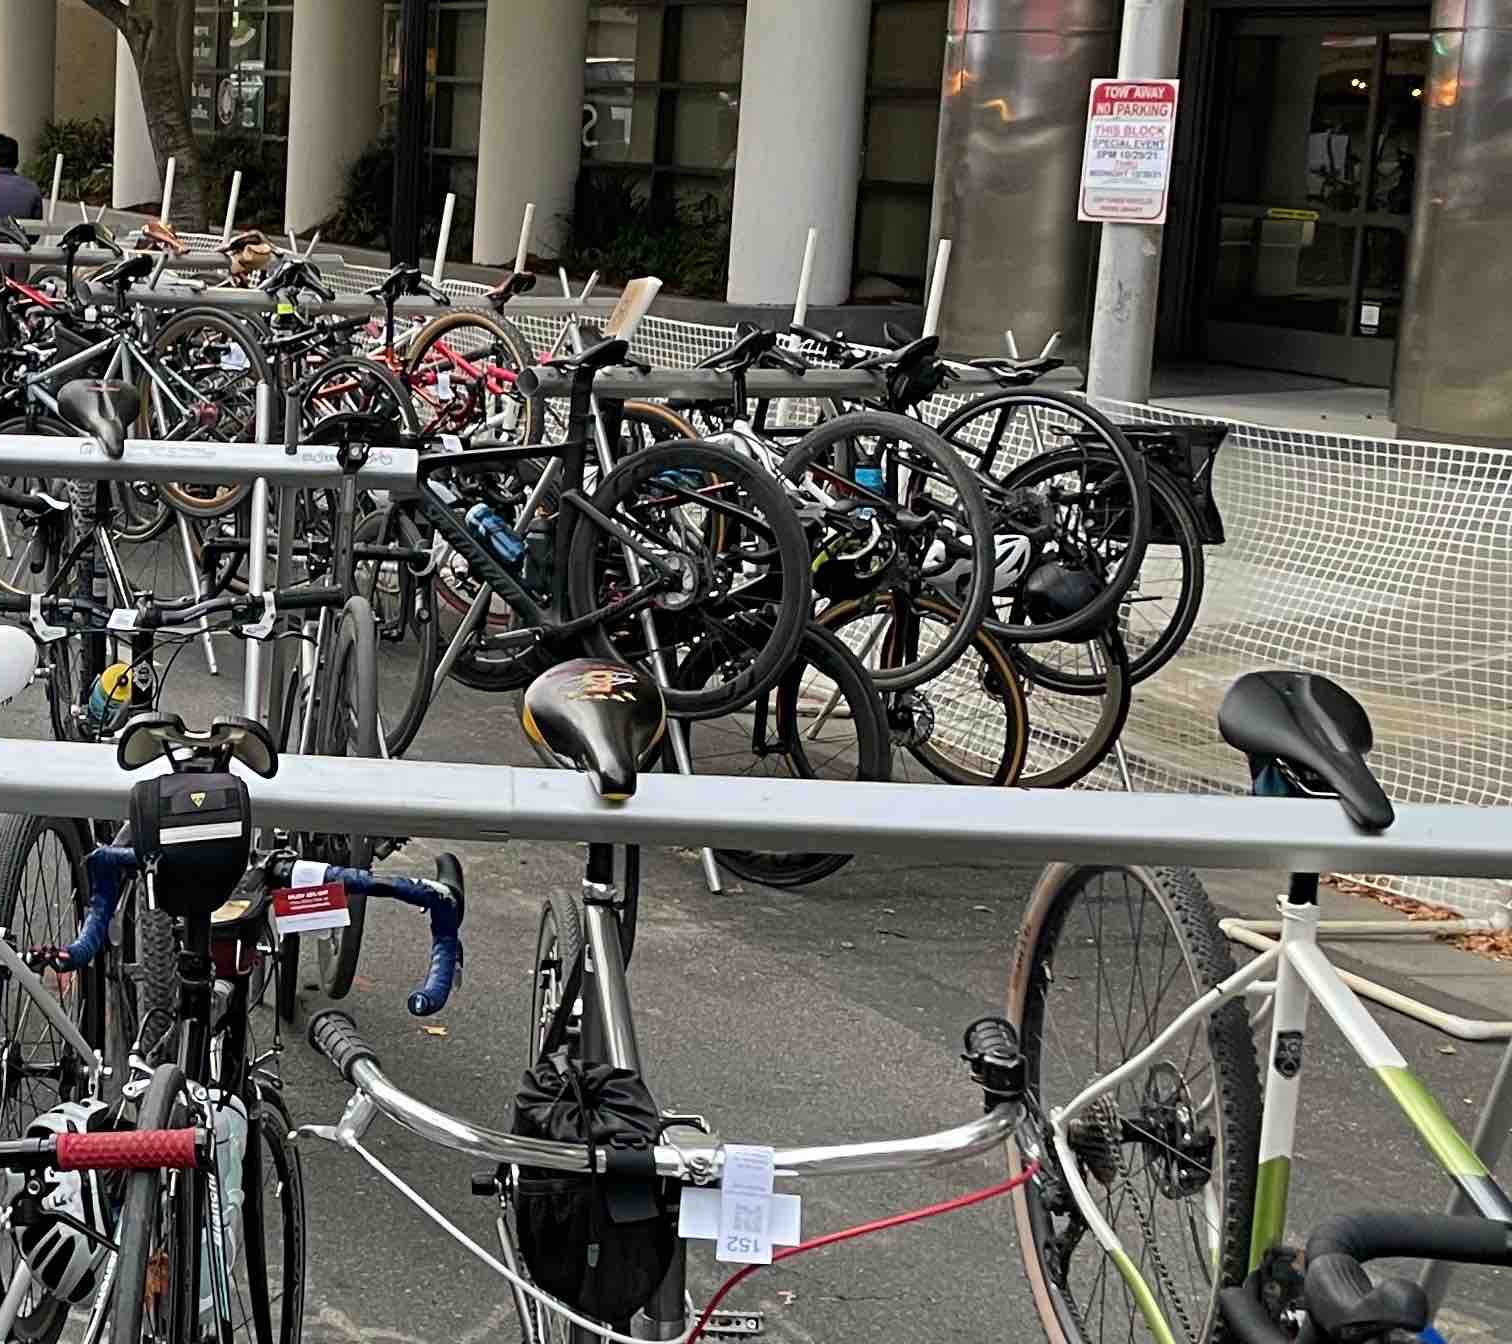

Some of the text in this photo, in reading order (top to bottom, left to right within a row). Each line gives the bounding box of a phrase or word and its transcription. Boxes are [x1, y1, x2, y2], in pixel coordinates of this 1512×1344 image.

[1104, 86, 1166, 99] TOW AWAY
[1096, 102, 1169, 117] NO PARKING
[1124, 125, 1167, 137] BLOCK
[727, 1235, 760, 1254] 152
